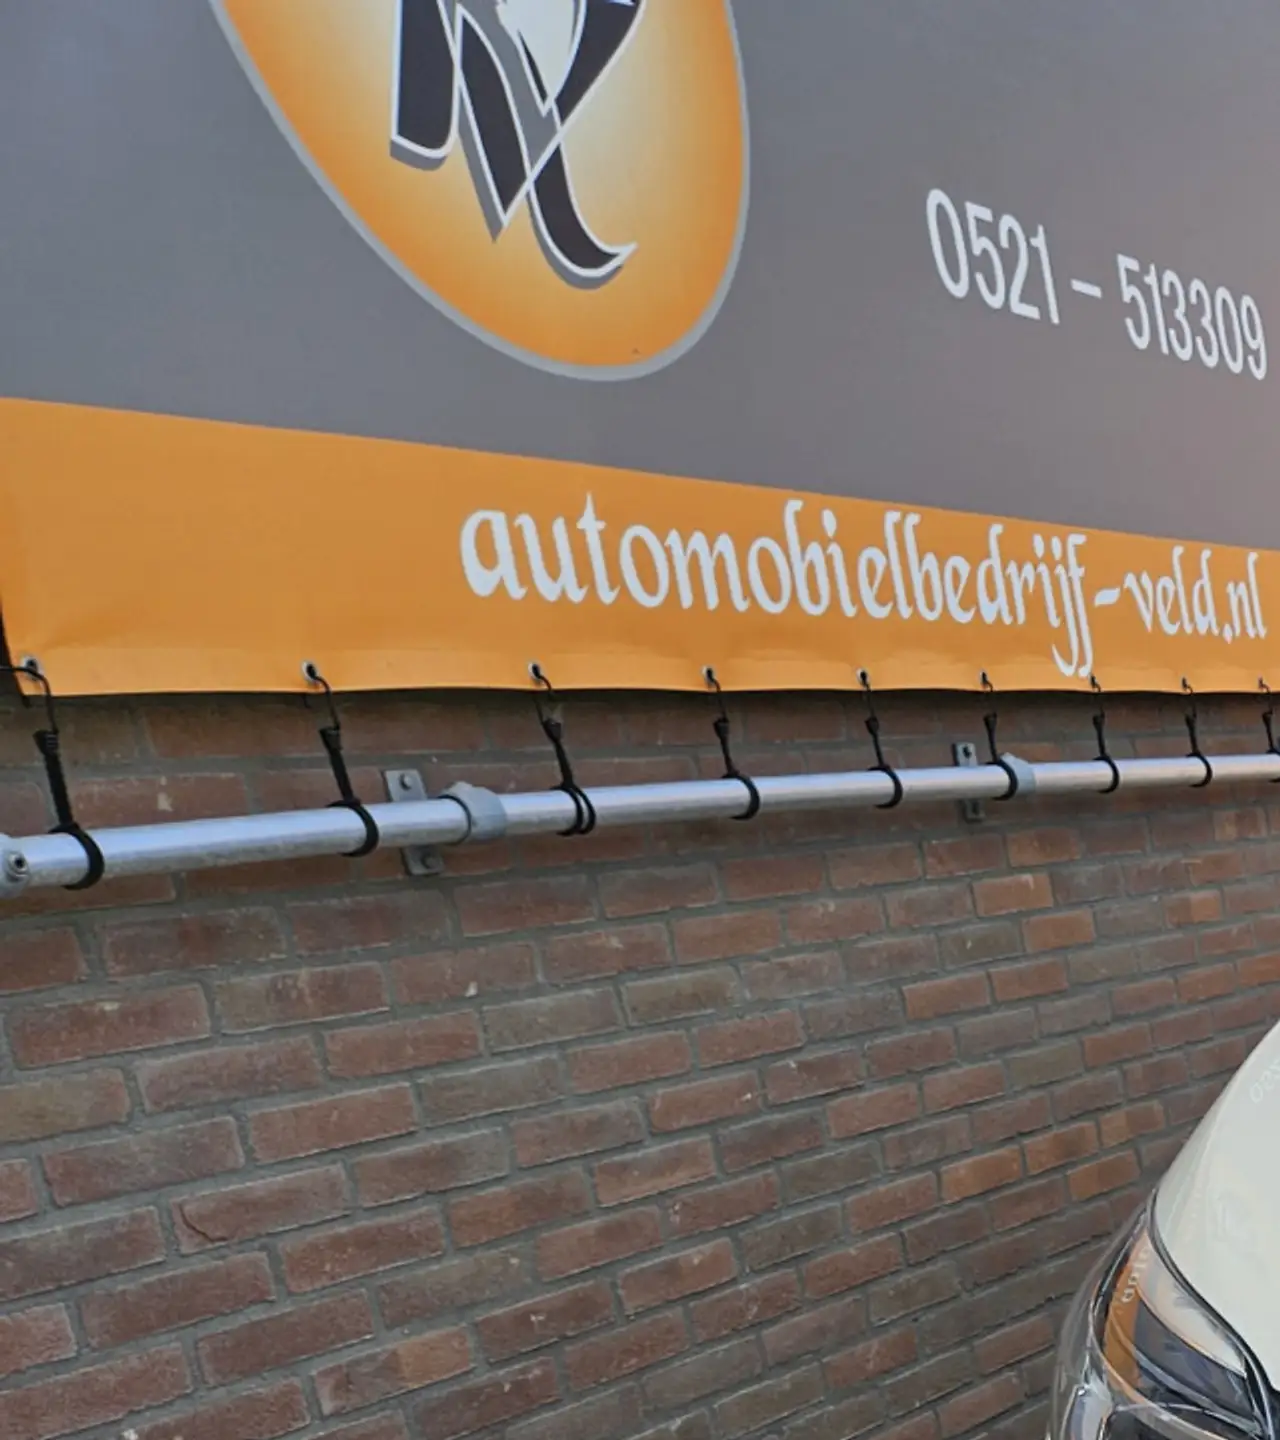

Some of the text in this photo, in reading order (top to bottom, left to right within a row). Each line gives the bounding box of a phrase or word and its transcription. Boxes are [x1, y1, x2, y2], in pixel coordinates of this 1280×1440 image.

[926, 187, 1268, 381] 0521 - 513309
[460, 491, 1268, 677] automobielbedrijf-veld.nl
